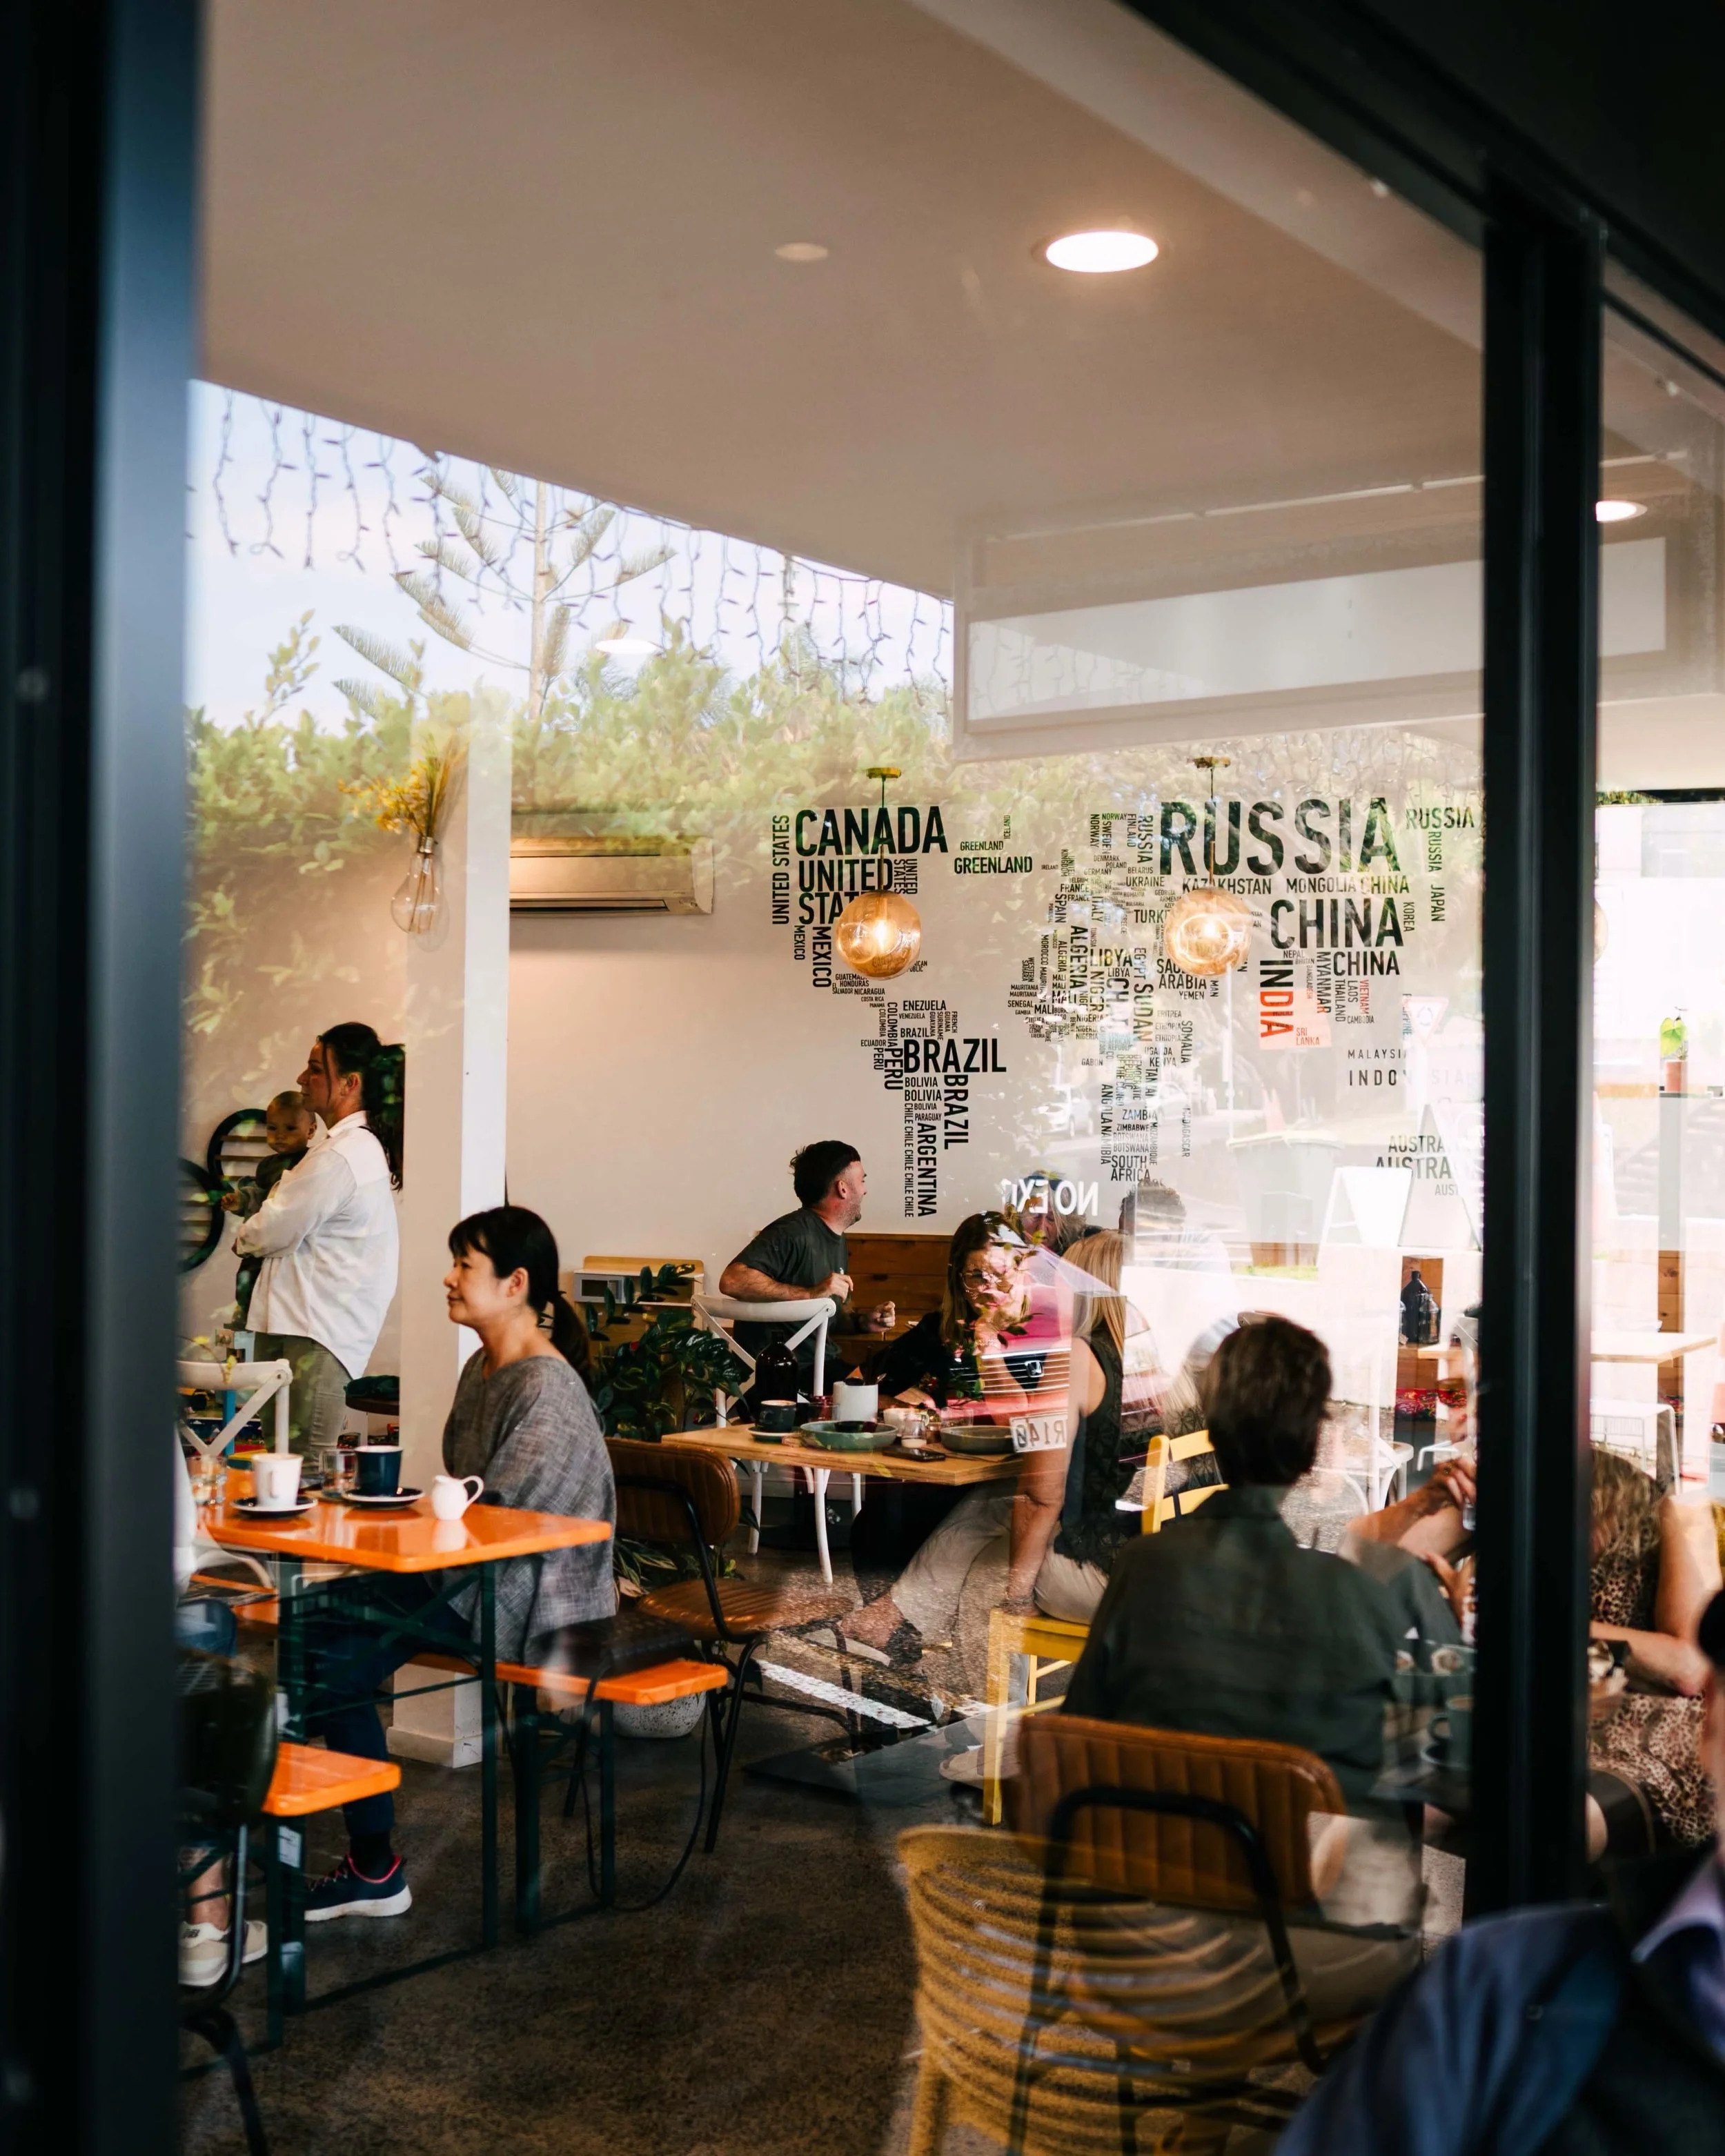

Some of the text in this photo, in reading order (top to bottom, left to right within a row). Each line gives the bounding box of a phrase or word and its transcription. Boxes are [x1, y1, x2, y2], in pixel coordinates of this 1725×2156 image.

[796, 806, 948, 856] CANADA
[1090, 814, 1100, 848] NORWAY
[1127, 813, 1137, 847] FINLAND
[1406, 807, 1475, 829] RUSSIA
[960, 840, 1004, 851] GREENLAND
[1102, 821, 1112, 855] SWEDEN
[1138, 815, 1154, 864] RUSSIA
[1160, 798, 1401, 876] RUSSIA
[1428, 831, 1443, 873] RUSSIA
[772, 815, 790, 924] UNITED STATES
[799, 858, 894, 892] UNITED
[894, 859, 906, 894] STATES
[905, 858, 918, 895] UNITED
[954, 856, 1033, 874] GREENLAND
[1061, 849, 1069, 877] KINGDOM
[1060, 883, 1090, 893] FRANCE
[1125, 876, 1165, 887] UKRAINE
[1286, 875, 1410, 894] MONGOLIA CHINA
[1055, 893, 1067, 923] SPAIN
[1092, 896, 1104, 922] ITALY
[1403, 902, 1415, 932] KOREA
[1431, 884, 1446, 922] JAPAN
[1270, 898, 1404, 949] CHINA
[794, 925, 805, 960] MEXICO
[812, 927, 832, 987] MEXICO
[1041, 935, 1049, 965] MOROCCO
[1058, 940, 1068, 973] ALGERIA
[1070, 925, 1089, 989] ALGERIA
[1090, 948, 1133, 967] LIBYA
[1283, 950, 1305, 958] NEPAL
[1107, 967, 1130, 978] LIBYA
[1134, 948, 1147, 980] EGYPT
[1333, 951, 1400, 976] CHINA
[854, 987, 885, 996] NICARAGUA
[1090, 971, 1105, 1012] NIGER
[1159, 973, 1208, 989] ARABIA
[1179, 991, 1205, 1000] YEMEN
[1317, 951, 1332, 1014] MYANMAR
[1347, 980, 1359, 1003] LAOS
[903, 1000, 947, 1011] ENEZUELA
[1007, 1000, 1034, 1008] SENEGAL
[1035, 1004, 1054, 1015] MALI
[1133, 983, 1154, 1042] SUDAN
[1259, 960, 1294, 1038] INDIA
[1334, 980, 1346, 1022] THAILAND
[1359, 980, 1370, 1015] VIETNAM
[887, 1002, 898, 1048] COLOMBIA
[900, 1028, 929, 1038] BRAZIL
[1297, 1027, 1308, 1036] SRI
[1347, 1015, 1375, 1024] CAMBODIA
[860, 1039, 887, 1047] ECUADOR
[904, 1038, 1007, 1074] BRAZIL
[1181, 1020, 1193, 1064] SOMALIA
[1297, 1036, 1320, 1046] LANKA
[874, 1047, 884, 1070] PERU
[884, 1048, 904, 1090] PERU
[1081, 1058, 1103, 1066] GABON
[1116, 1066, 1125, 1079] THE
[1125, 1054, 1134, 1090] REPUBLIC
[905, 1077, 938, 1087] BOLIVIA
[1134, 1055, 1143, 1100] DEMOCRATIC
[905, 1089, 943, 1102] BOLIVIA
[1101, 1084, 1114, 1124] ANGOLA
[915, 1113, 942, 1121] PARAGUAY
[944, 1074, 969, 1150] BRAZIL
[1122, 1109, 1158, 1120] ZAMBIA
[1113, 1132, 1149, 1143] BOTSWANA
[1116, 1123, 1150, 1132] ZIMBABWE
[1101, 1125, 1112, 1165] NAMIBIA
[1113, 1143, 1150, 1153] BOTSWANA
[1149, 1122, 1159, 1166] MOZAMBIQUE
[905, 1103, 914, 1218] CHILE CHILE CHILE CHILE CHILE
[917, 1122, 937, 1217] ARGENTINA
[1110, 1168, 1151, 1182] AFRICA
[1111, 1155, 1147, 1169] SOUTH
